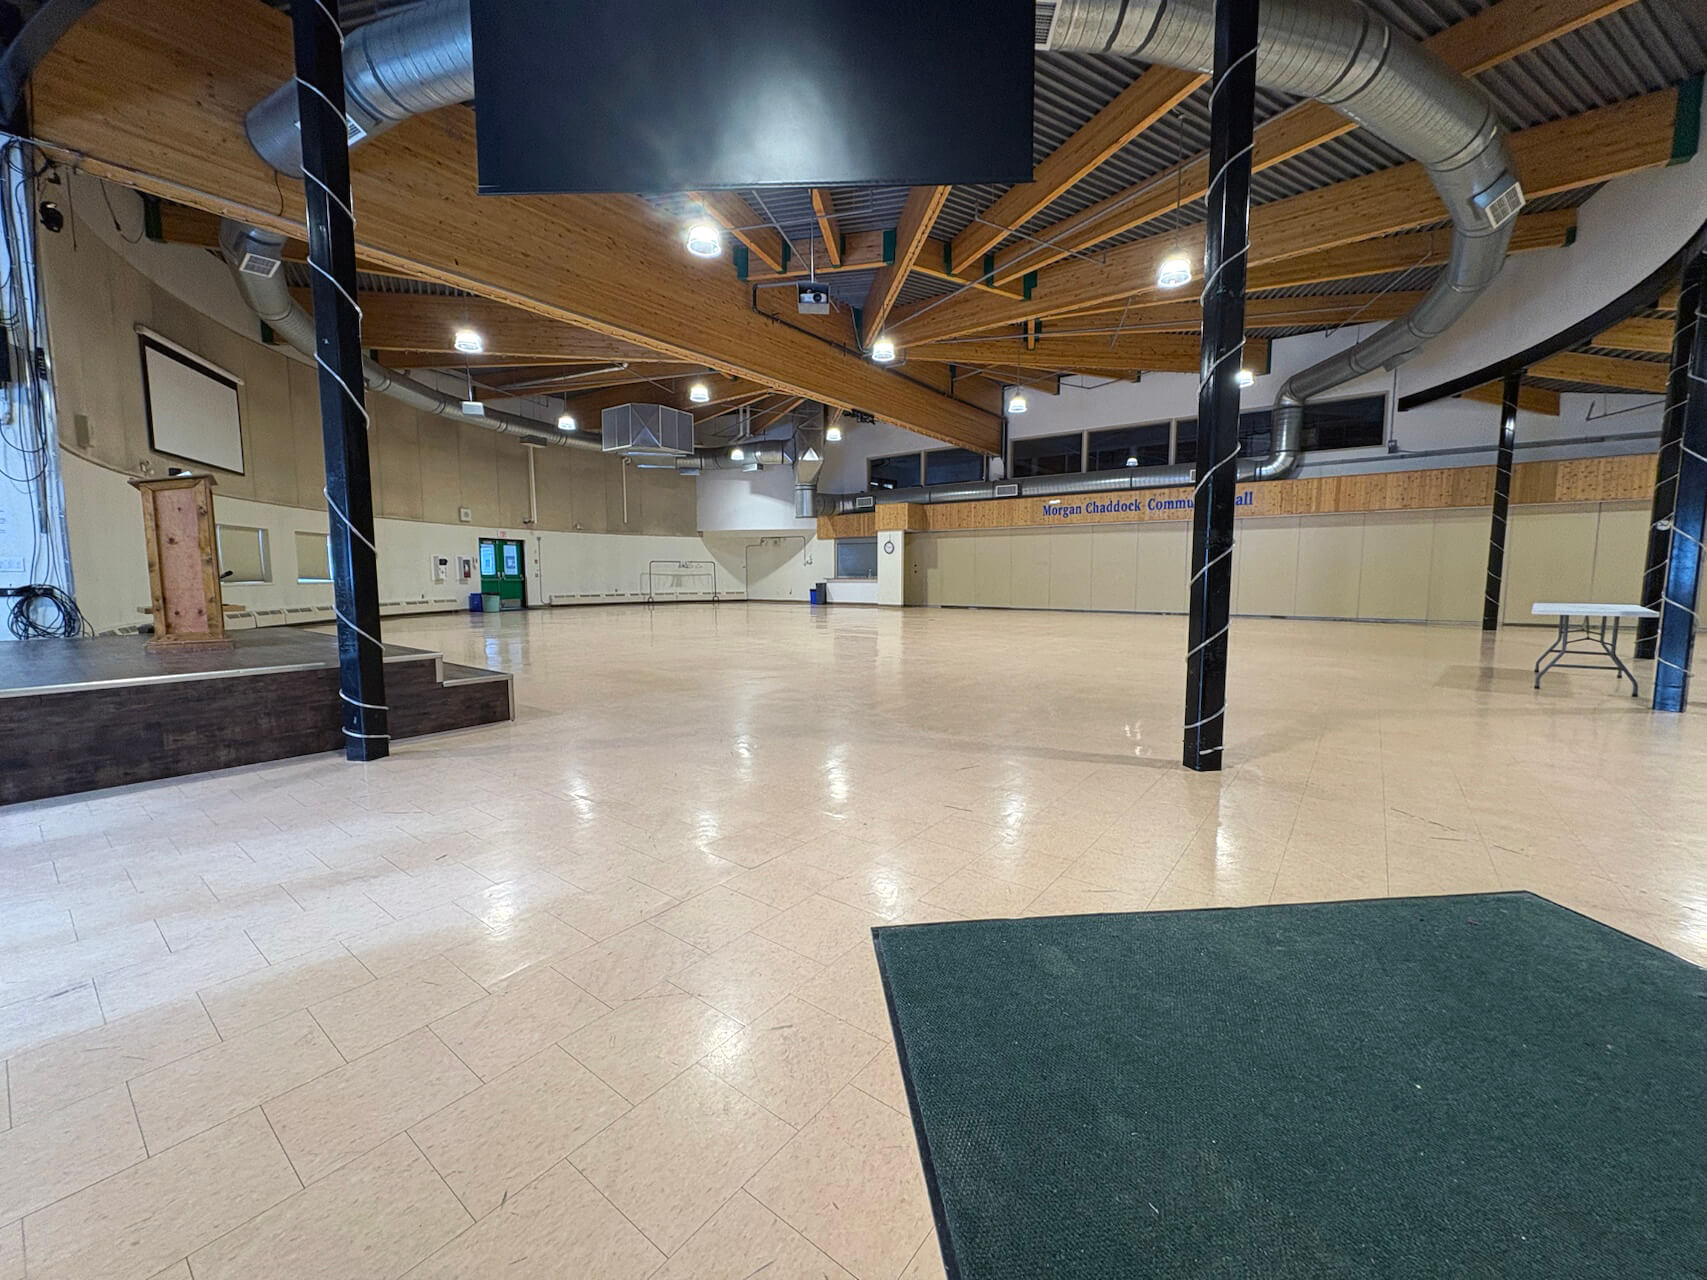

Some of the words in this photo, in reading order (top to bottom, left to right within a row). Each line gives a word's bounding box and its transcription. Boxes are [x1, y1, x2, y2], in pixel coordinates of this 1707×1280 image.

[1042, 504, 1082, 518] Morgan
[1085, 499, 1141, 514] Chaddock
[1147, 498, 1195, 511] Commu
[1235, 491, 1254, 506] all
